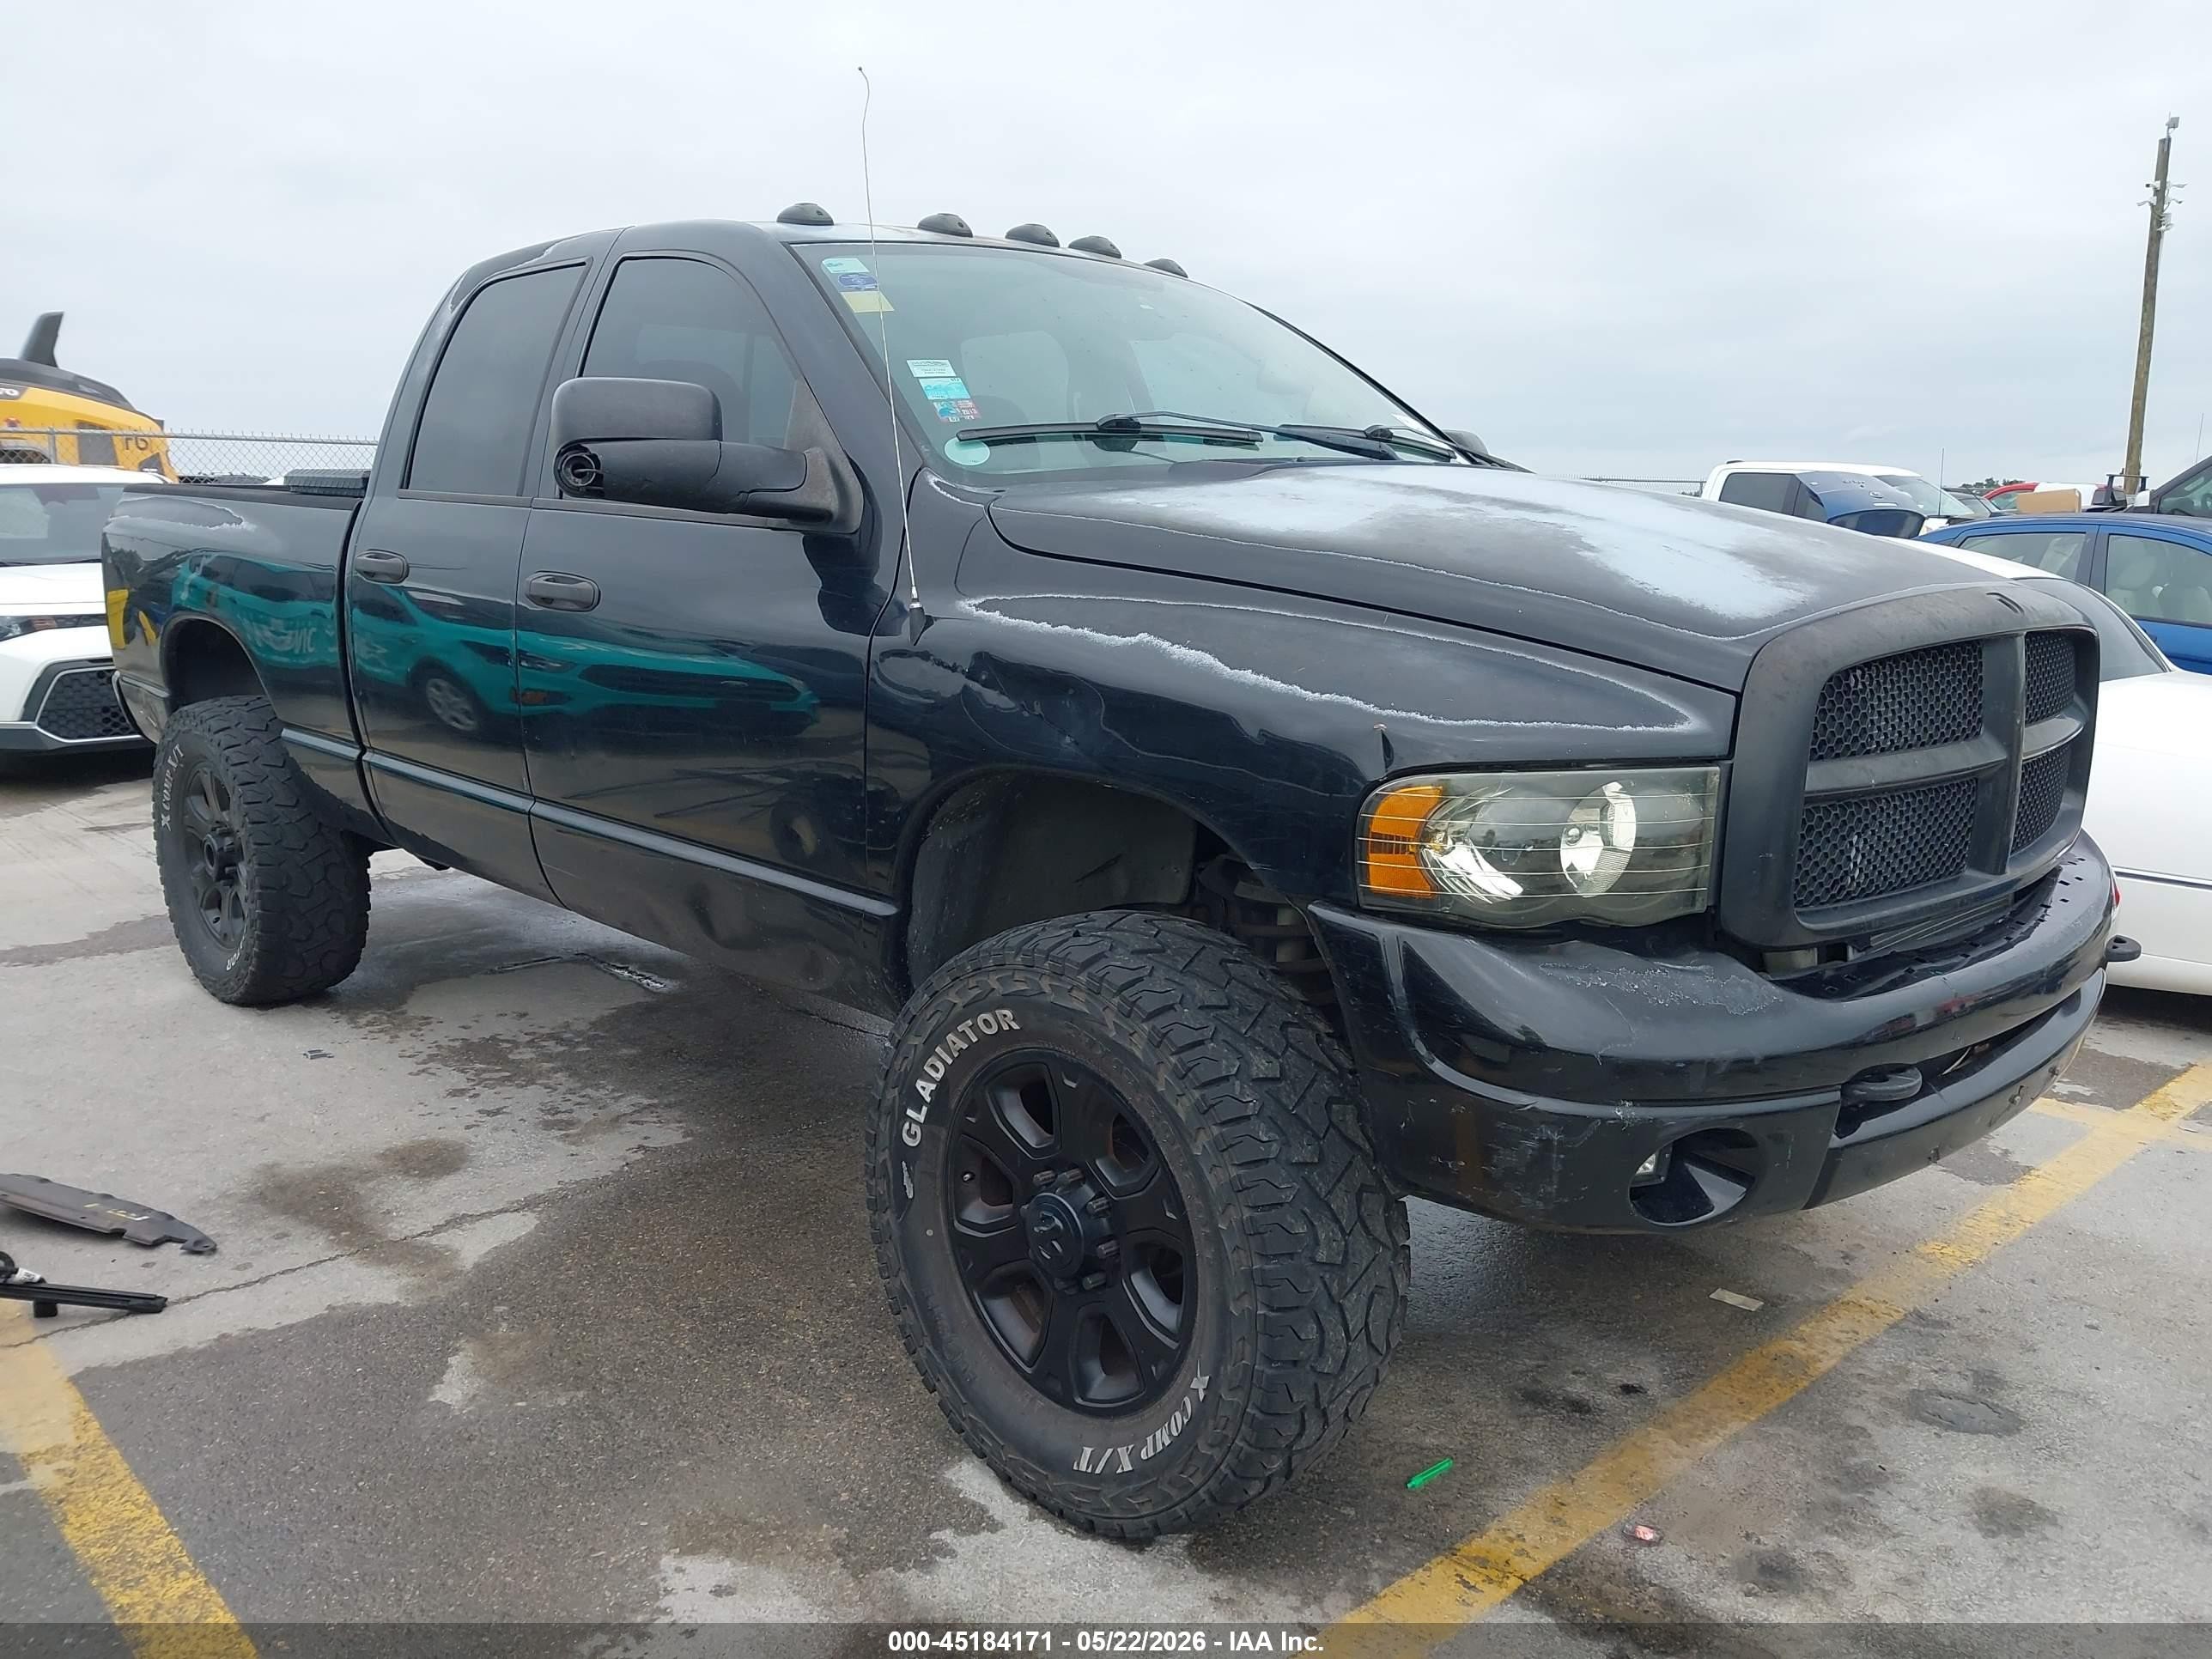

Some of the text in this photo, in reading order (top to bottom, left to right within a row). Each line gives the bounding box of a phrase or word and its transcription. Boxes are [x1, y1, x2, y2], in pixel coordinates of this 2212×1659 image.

[161, 813, 173, 832] X
[902, 1009, 1020, 1147] GLADIATOR
[1073, 1359, 1210, 1474] X COMP X/T
